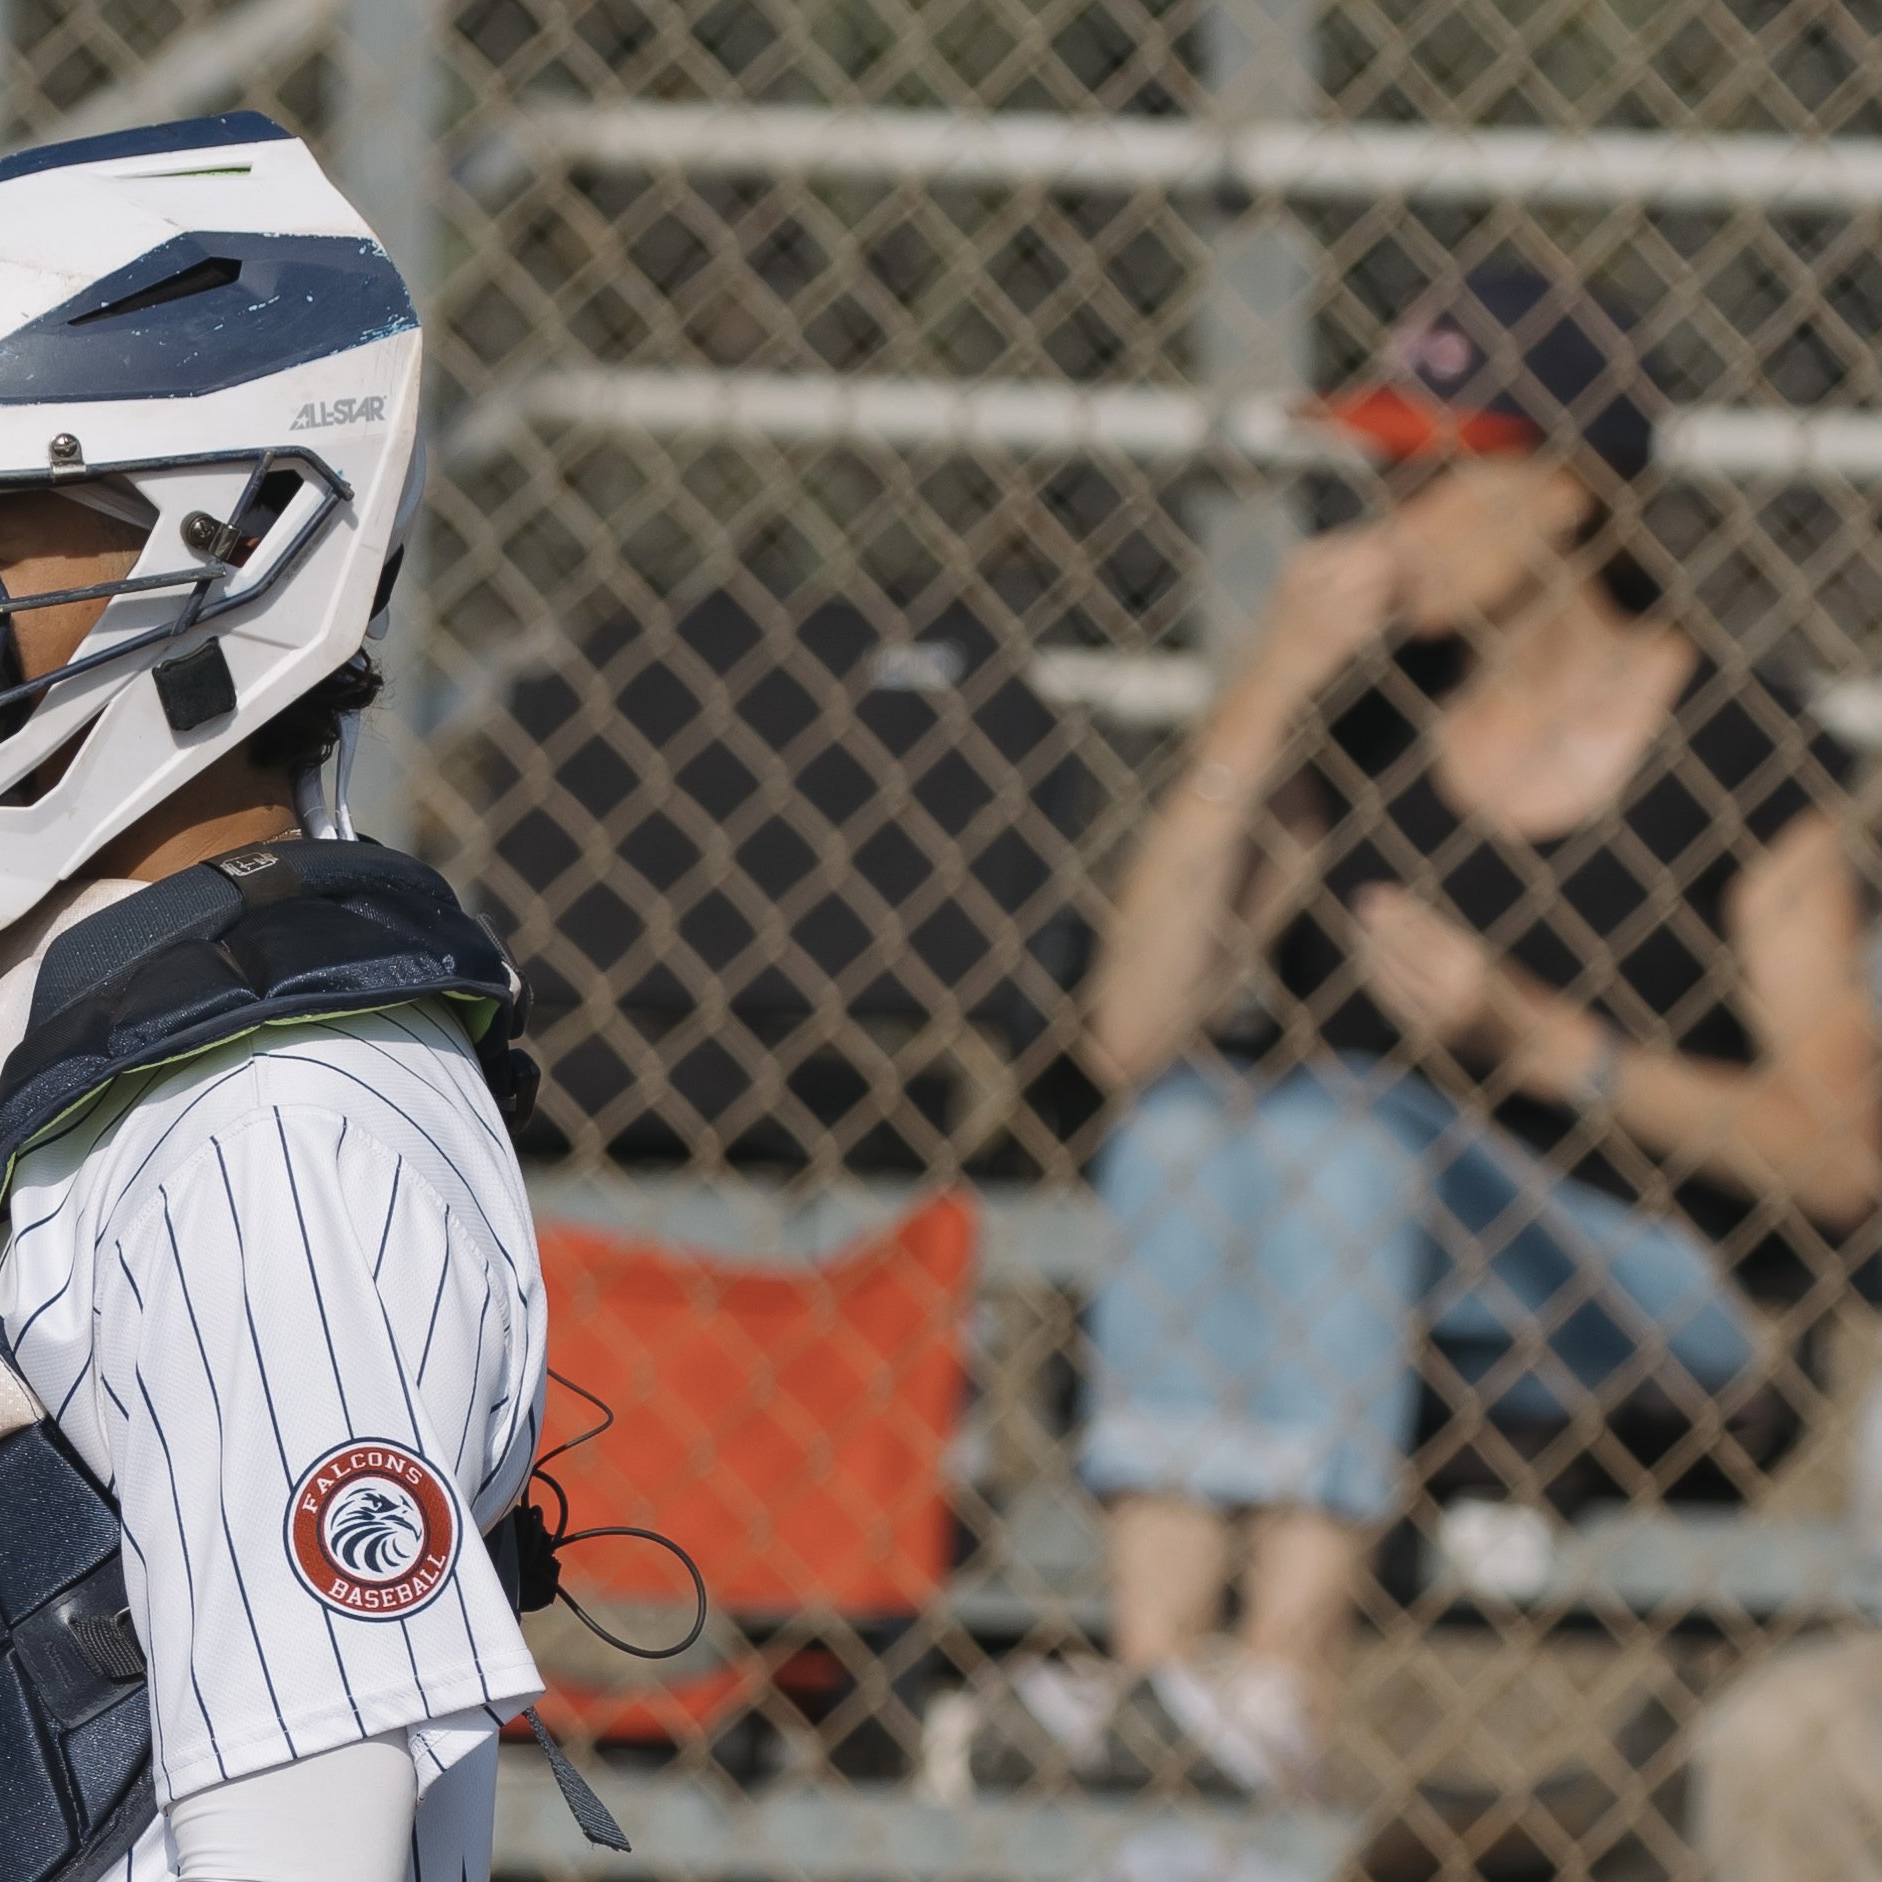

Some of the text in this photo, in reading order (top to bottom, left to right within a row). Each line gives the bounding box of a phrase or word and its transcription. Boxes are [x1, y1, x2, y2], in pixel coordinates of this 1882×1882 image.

[289, 396, 385, 431] ALL-STAR
[302, 1452, 423, 1514] FALCONS
[329, 1554, 446, 1609] BASEBALL
